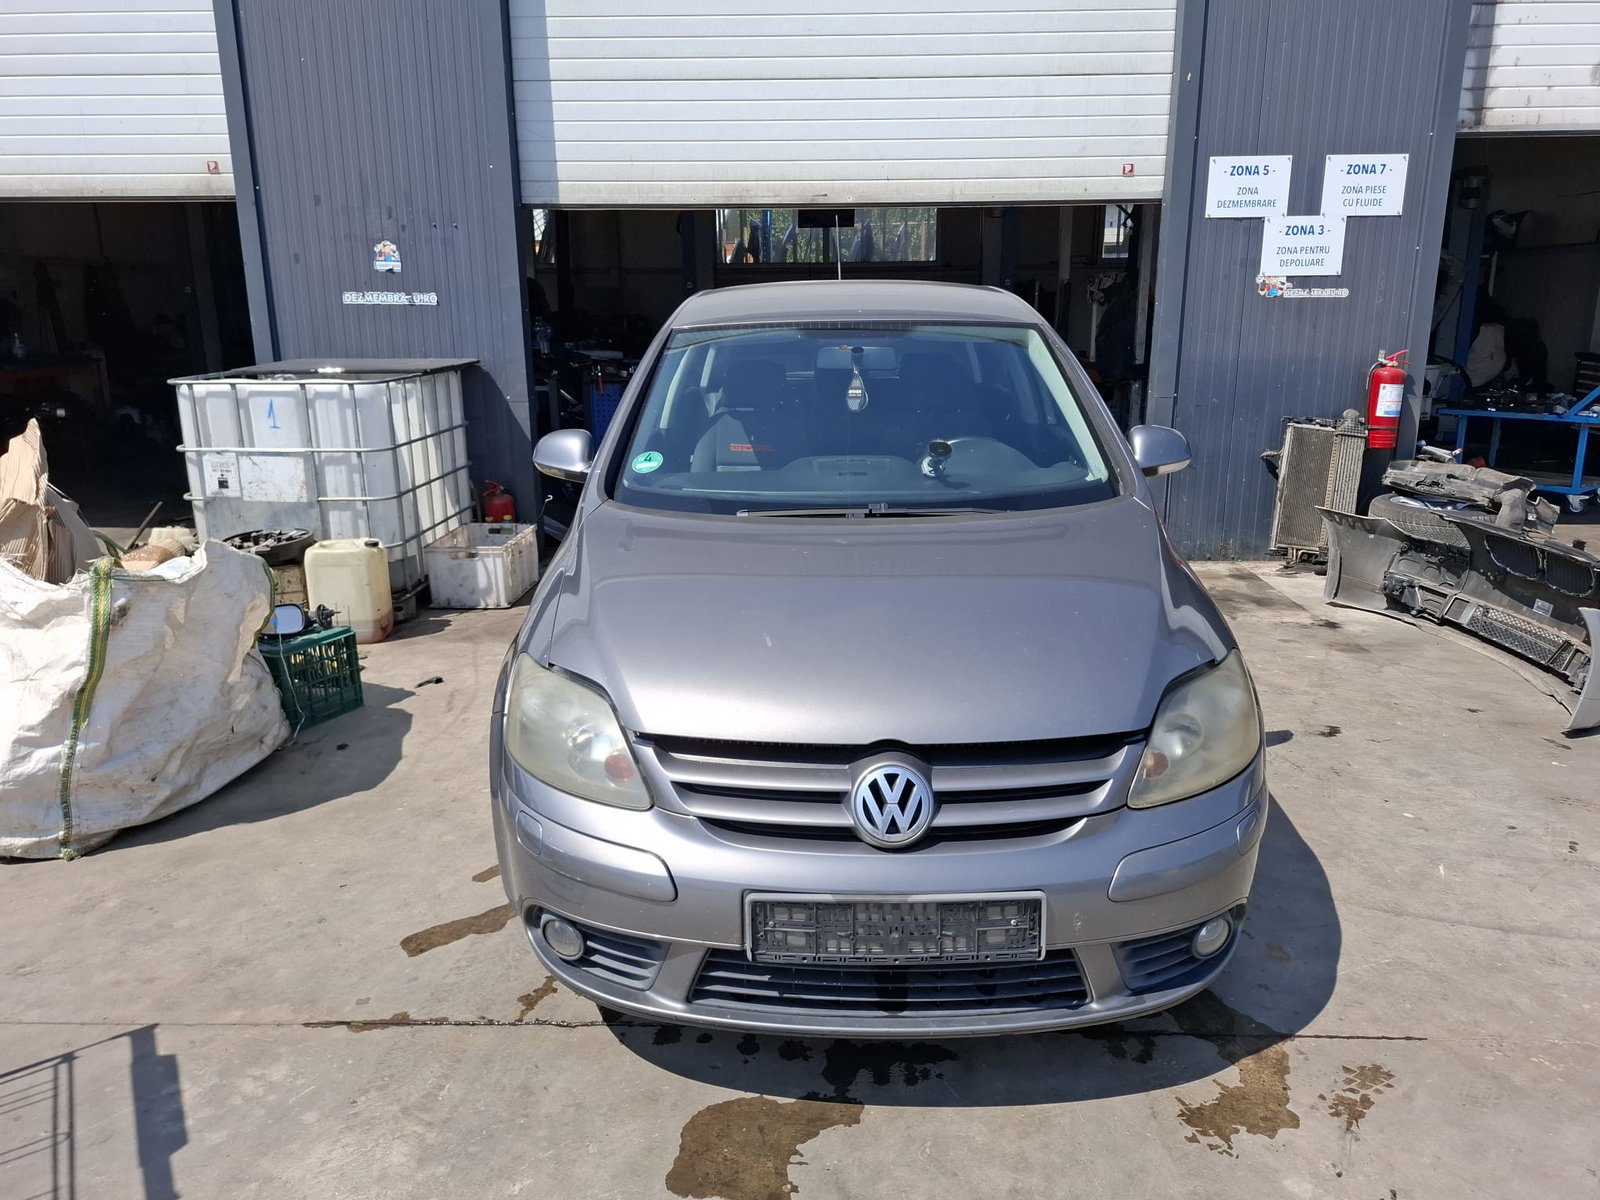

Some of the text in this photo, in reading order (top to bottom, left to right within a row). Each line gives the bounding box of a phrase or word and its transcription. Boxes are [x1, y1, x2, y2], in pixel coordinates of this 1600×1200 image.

[1230, 165, 1260, 176] ZONA
[1262, 164, 1270, 176] 5
[1346, 164, 1376, 174] ZONA
[1380, 164, 1387, 174] 7
[1236, 186, 1259, 196] ZONA
[1341, 186, 1387, 194] ZONA PIESE
[1216, 199, 1278, 208] DEZMEMBRARE
[1342, 198, 1384, 206] CU FLUIDE
[1284, 225, 1315, 236] ZONA
[1318, 224, 1325, 236] 3
[1276, 246, 1330, 255] ZONA PENTRU
[1280, 258, 1325, 268] DEPOLUARE
[268, 399, 282, 430] 1
[644, 452, 652, 462] 4
[855, 766, 930, 842] VW
